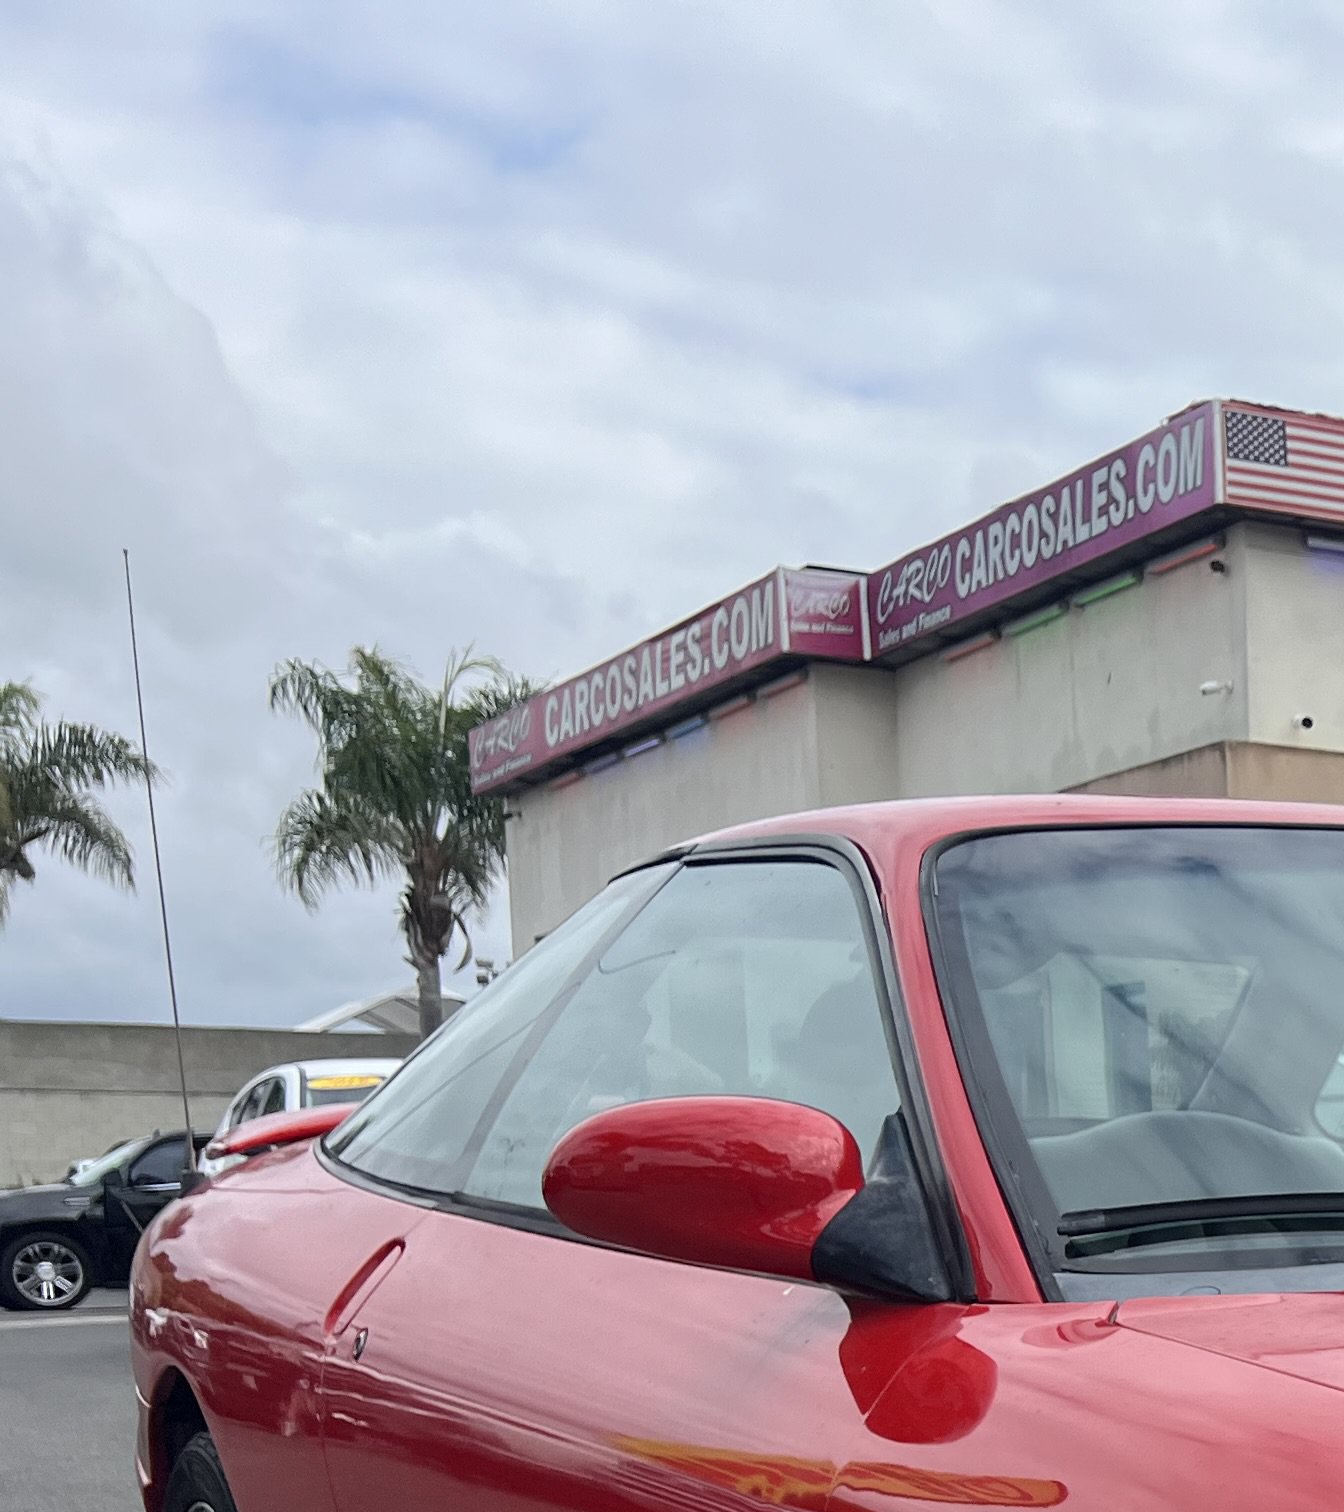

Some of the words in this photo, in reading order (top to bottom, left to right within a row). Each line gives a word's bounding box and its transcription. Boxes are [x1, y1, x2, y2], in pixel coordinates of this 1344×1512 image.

[877, 543, 952, 624] CARCO
[955, 416, 1205, 599] CARCOSALES.COM
[544, 580, 774, 748] CARCOSALES.COM
